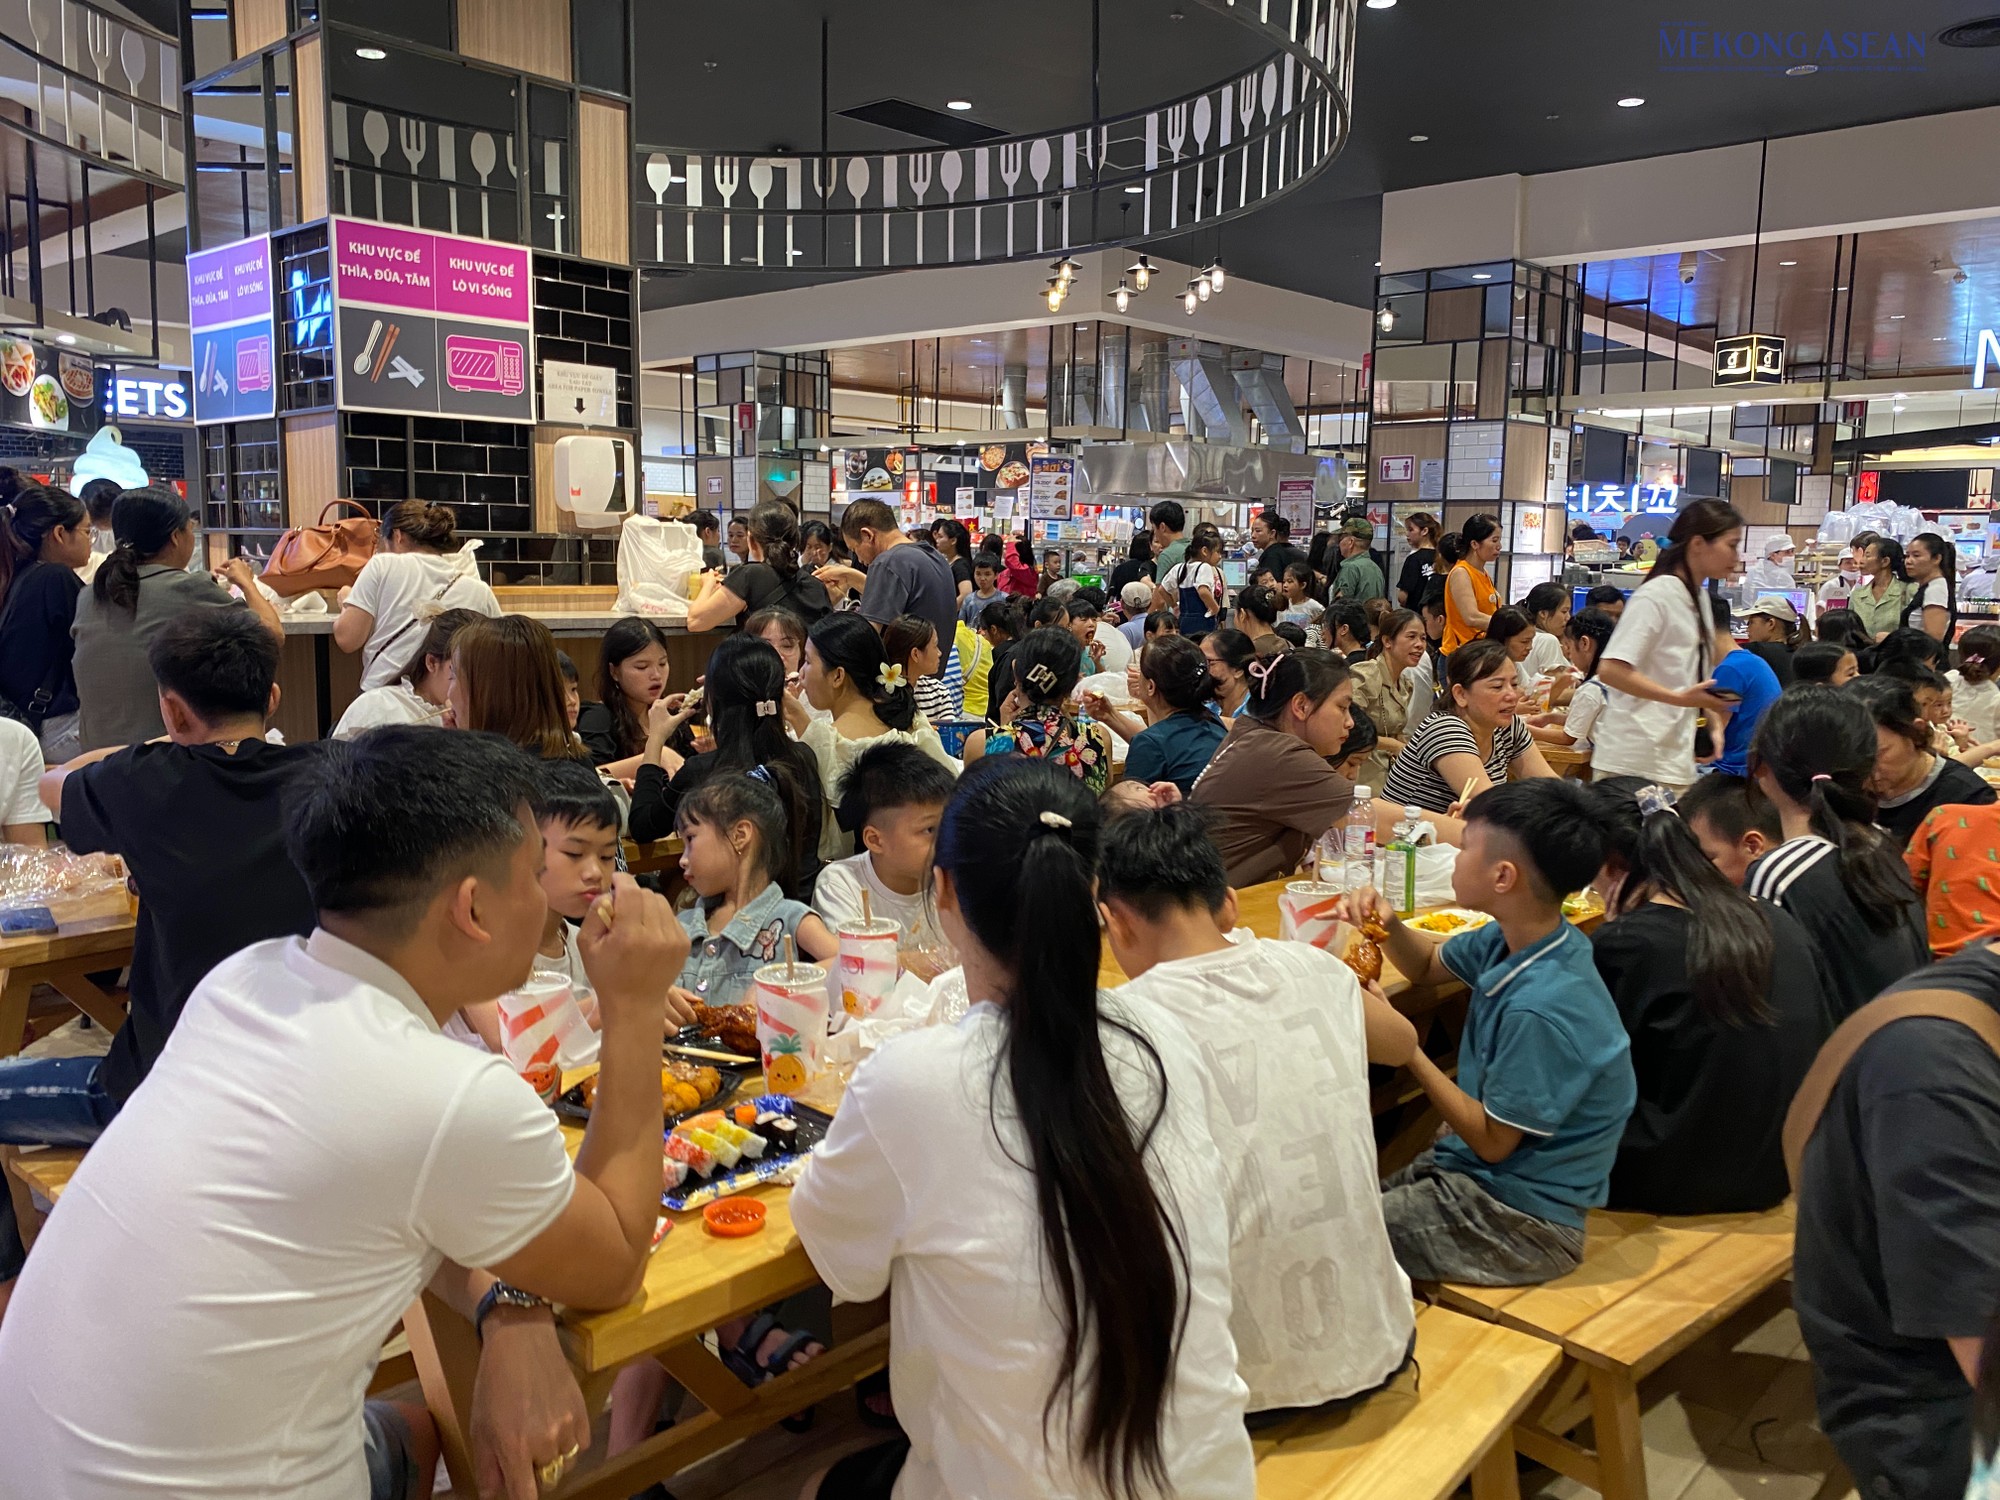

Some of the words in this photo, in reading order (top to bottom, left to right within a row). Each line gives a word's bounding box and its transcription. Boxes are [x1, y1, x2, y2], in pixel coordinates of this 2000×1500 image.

[349, 241, 375, 256] KHU
[377, 246, 402, 262] VỰC
[404, 248, 421, 263] ĐỂ
[234, 264, 245, 276] KHU
[245, 260, 256, 275] VỰC
[340, 263, 372, 280] THÌA,
[374, 268, 404, 285] ĐŨA,
[405, 272, 430, 287] TĂM
[449, 257, 473, 272] KHU
[474, 261, 498, 276] VỰC
[499, 264, 514, 277] ĐỂ
[194, 274, 205, 285] KHU
[452, 278, 467, 292] LÒ
[468, 282, 480, 294] VI
[481, 283, 512, 299] SÓNG
[105, 379, 187, 418] ETS
